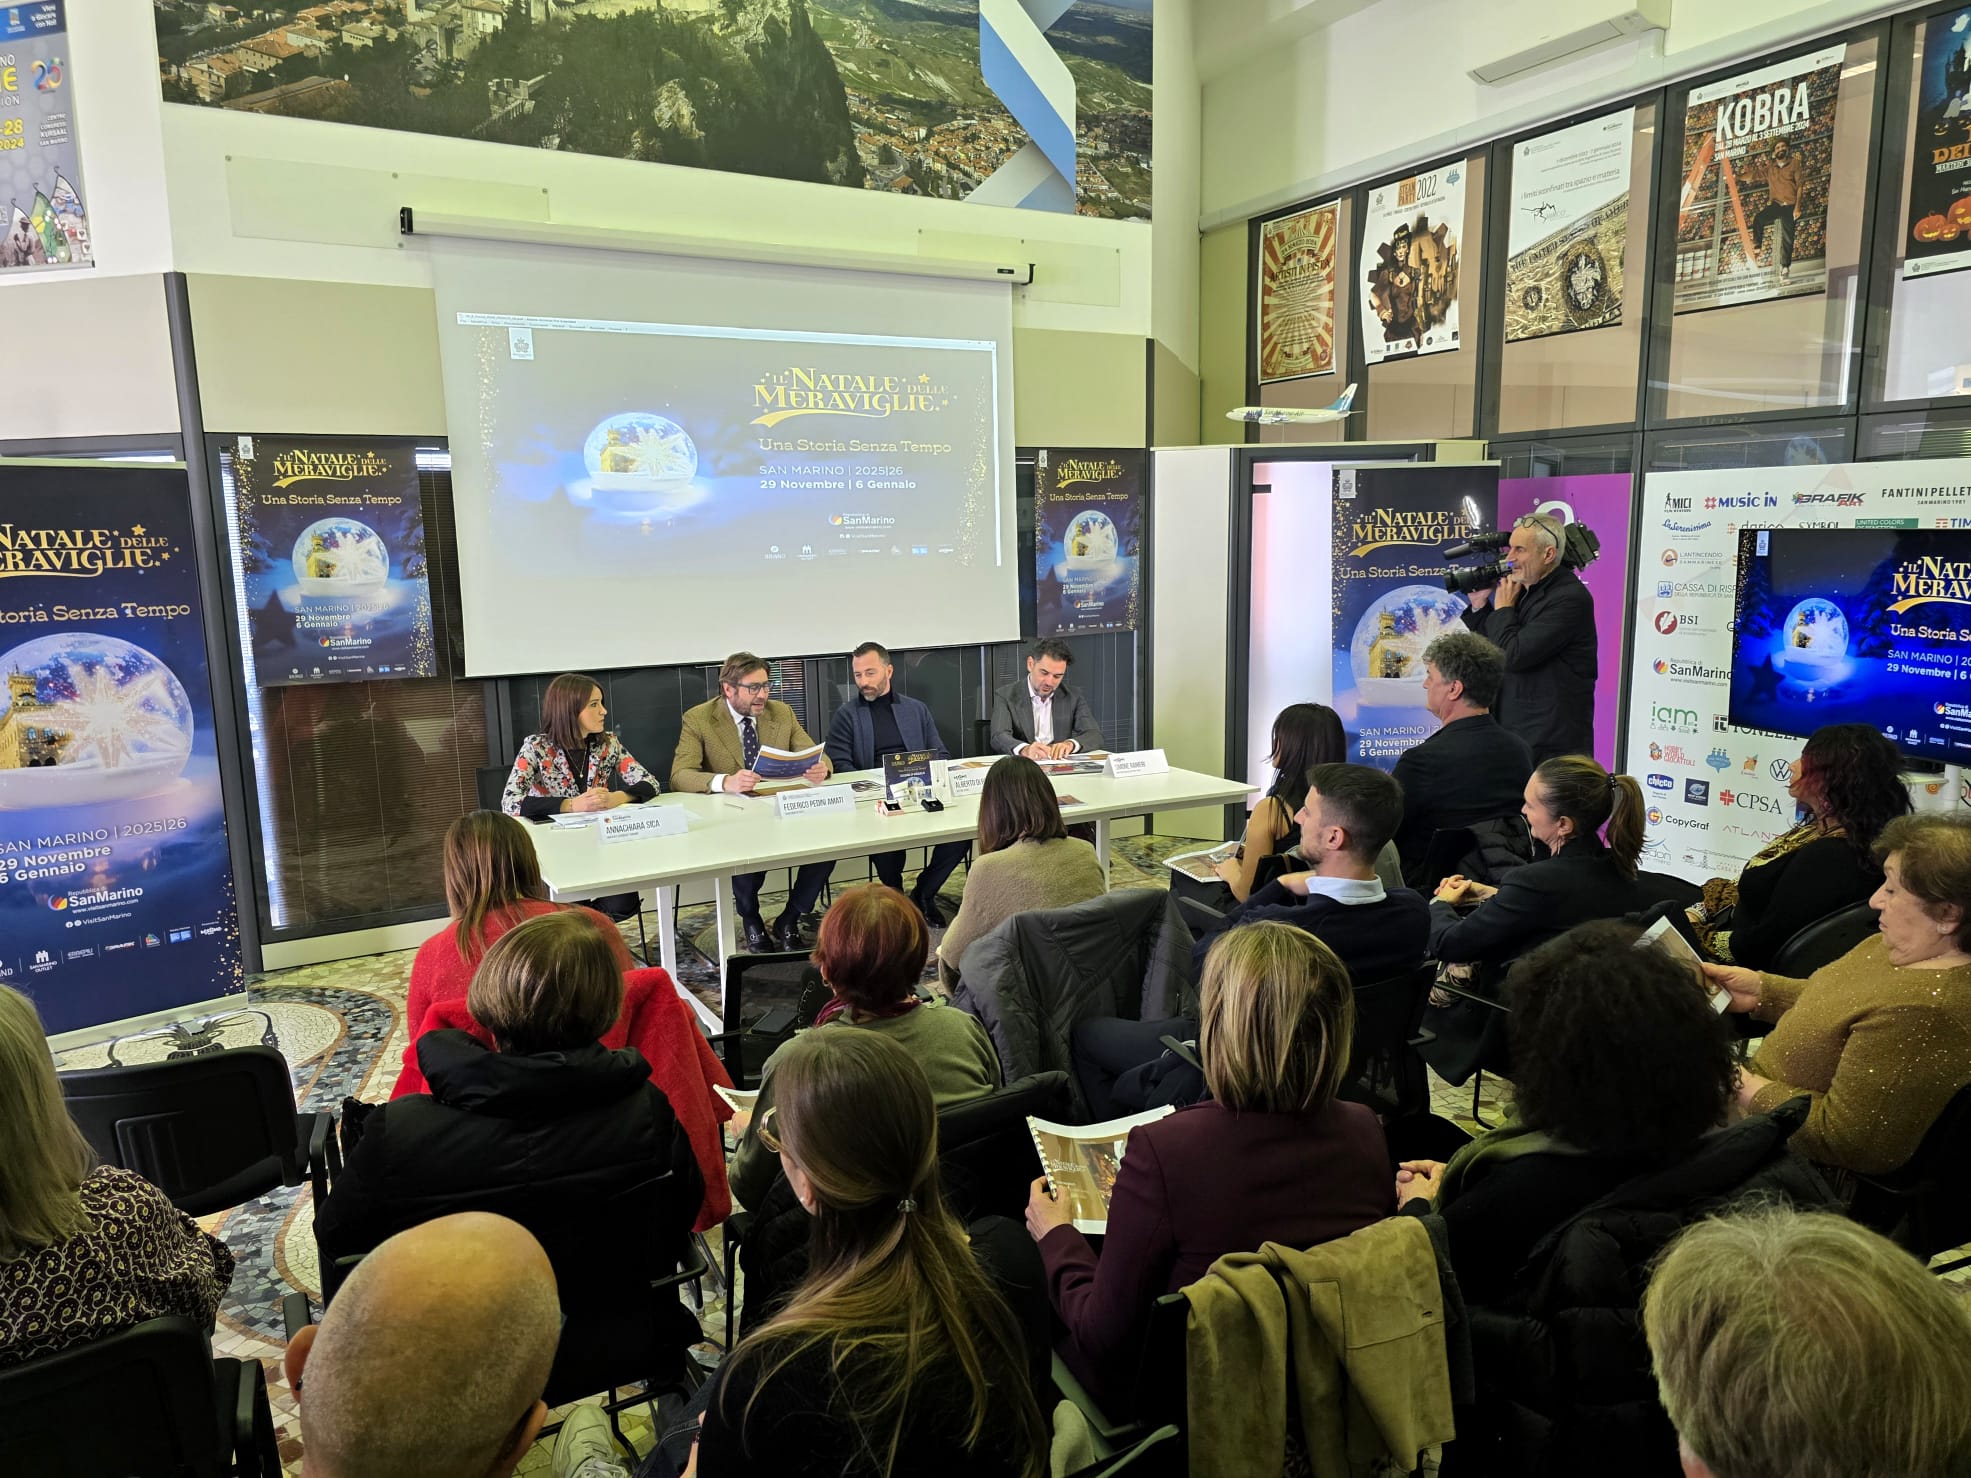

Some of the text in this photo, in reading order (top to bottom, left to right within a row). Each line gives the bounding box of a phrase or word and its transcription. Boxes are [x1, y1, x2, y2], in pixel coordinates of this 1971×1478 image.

[1716, 81, 1810, 143] KOBRA
[1763, 124, 1794, 139] SETTEMBRE
[1714, 146, 1747, 161] SAN MARINO
[1597, 168, 1620, 179] materia
[1417, 174, 1437, 201] 2022
[1270, 258, 1331, 283] ARTISTI IN PISTA
[790, 367, 900, 393] NATALE
[907, 384, 949, 395] DELLE
[752, 384, 936, 418] MERAVIGLIE
[759, 438, 952, 455] Una Storia Senza Tempo
[293, 449, 357, 465] NATALE
[1069, 459, 1105, 470] NATALE
[273, 461, 379, 479] MERAVIGLIE
[759, 465, 787, 475] SAN
[791, 465, 844, 475] MARINO
[1057, 468, 1118, 481] MERAVIGLIE
[760, 479, 916, 489] 29 Novembre 6 Gennaio
[261, 494, 402, 506] Una Storia Senza Tempo
[1050, 493, 1064, 501] Una
[1065, 493, 1085, 501] Storia
[1106, 492, 1129, 501] Tempo
[1664, 492, 1692, 509] AMICI
[1802, 492, 1867, 504] GRAFIK
[1881, 488, 1928, 498] FANTINI
[843, 515, 895, 525] SanMarino
[1364, 507, 1449, 527] IL NATALE
[1351, 524, 1474, 542] MERAVIGLIE
[1670, 520, 1712, 533] Serenissima
[120, 537, 169, 547] DELLE
[1340, 567, 1366, 579] Una
[1368, 565, 1406, 578] Storia
[1908, 563, 1919, 572] IL
[1674, 583, 1705, 593] CASSA
[1707, 584, 1717, 593] DI
[53, 605, 118, 621] Senza
[121, 602, 191, 619] Tempo
[316, 604, 350, 612] MARINO
[309, 613, 351, 621] Novembre
[1680, 614, 1699, 625] BSI
[1890, 623, 1957, 640] Una Storia
[331, 638, 372, 646] SanMarino
[1887, 649, 1953, 664] SAN MARINO
[1886, 663, 1967, 680] 29 Novembre 6
[1359, 726, 1425, 737] SAN MARINO
[1359, 739, 1372, 748] 29
[1359, 748, 1407, 757] 6 Gennai
[1664, 751, 1684, 759] WORLD
[1648, 775, 1673, 788] chicco
[783, 796, 844, 811] FEDERICO PEDINI AMATI
[1736, 792, 1783, 815] CPSA
[606, 819, 660, 834] ANNACHIARA SICA
[1665, 815, 1710, 831] CopyGraf
[37, 817, 187, 849] MARINO 2025|26
[0, 846, 111, 871] 29 Novembre
[0, 861, 86, 884] 6 Gennaio
[68, 887, 100, 896] Repubblica
[69, 886, 143, 907] SanMarino
[82, 911, 132, 926] VisitSanMarino
